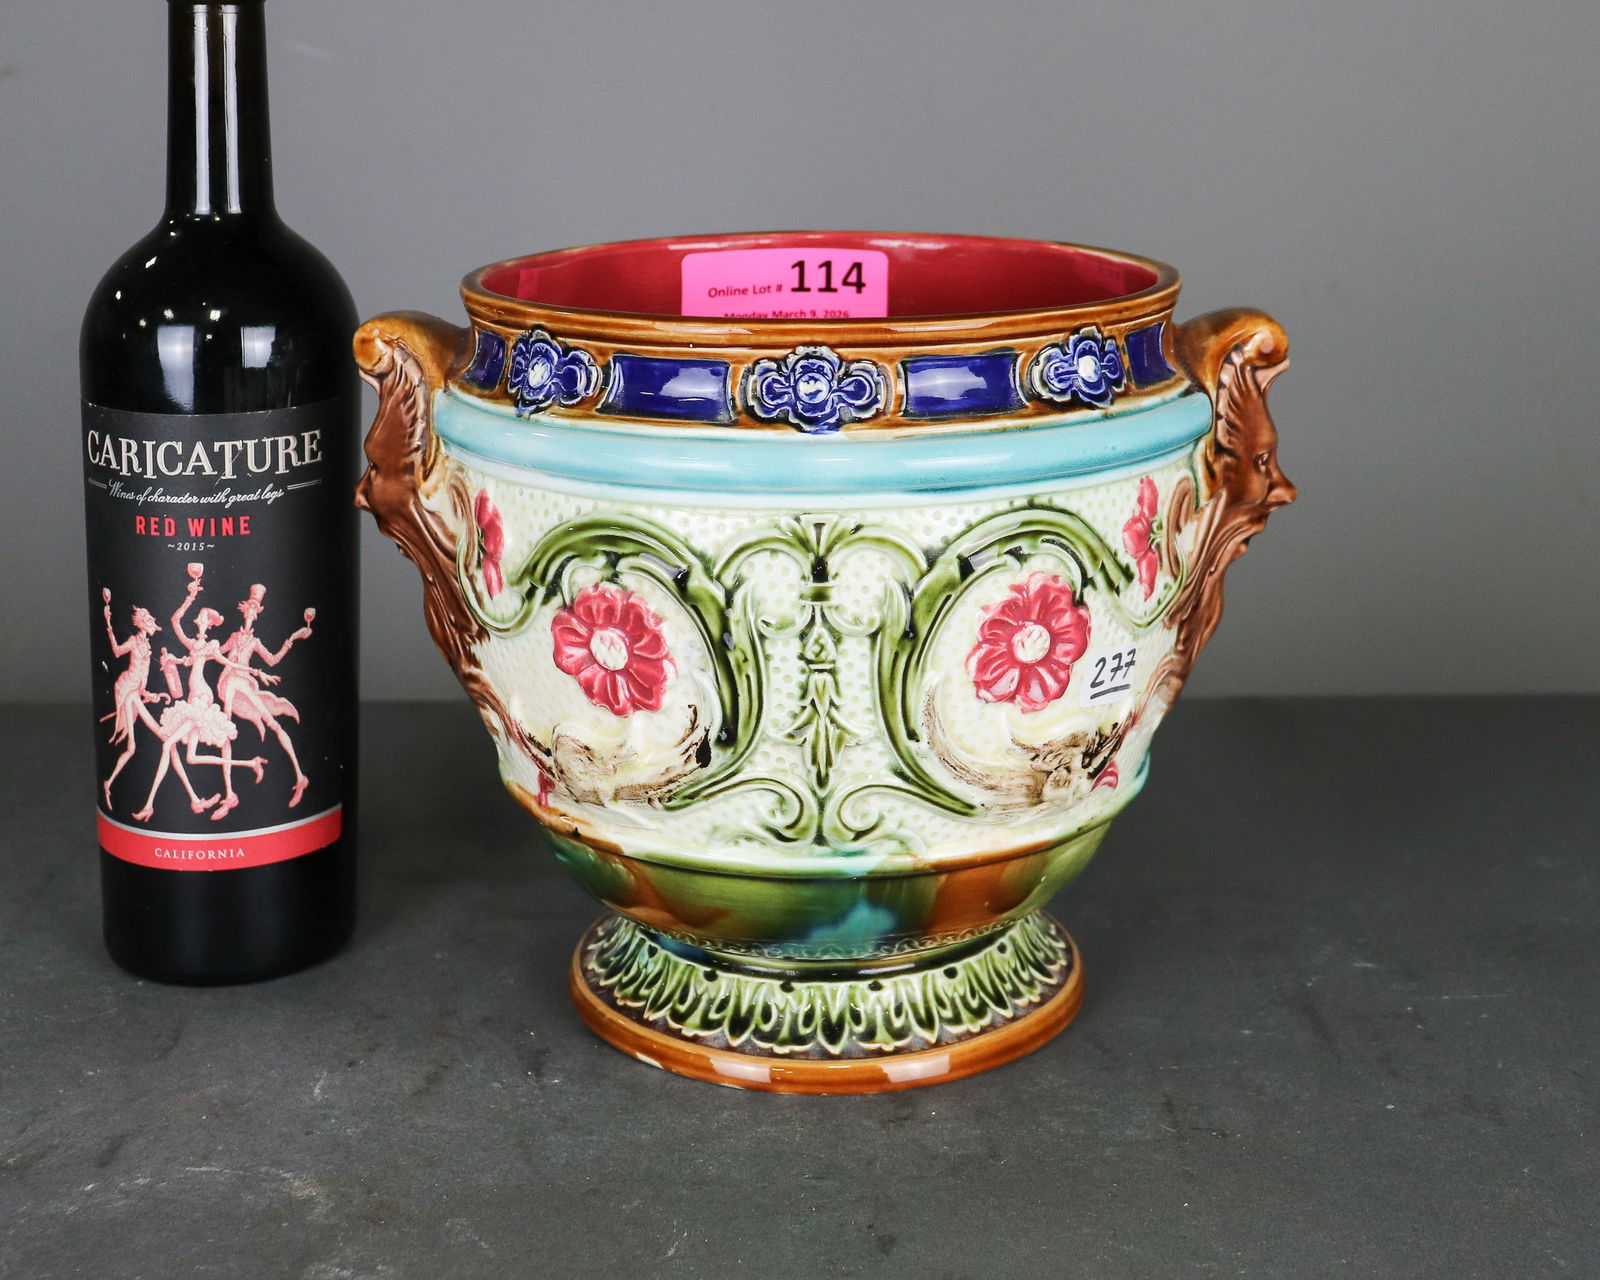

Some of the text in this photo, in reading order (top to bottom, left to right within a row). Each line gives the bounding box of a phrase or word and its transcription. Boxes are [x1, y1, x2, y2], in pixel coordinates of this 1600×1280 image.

[708, 260, 866, 298] Online Lot # 114
[771, 309, 807, 318] March
[823, 309, 850, 318] 2026
[87, 429, 323, 480] CARICATURE
[108, 479, 285, 509] Wines of character with great legs
[135, 515, 252, 537] RED WINE
[1090, 648, 1137, 688] 277
[154, 847, 245, 860] CALIFORNIA
